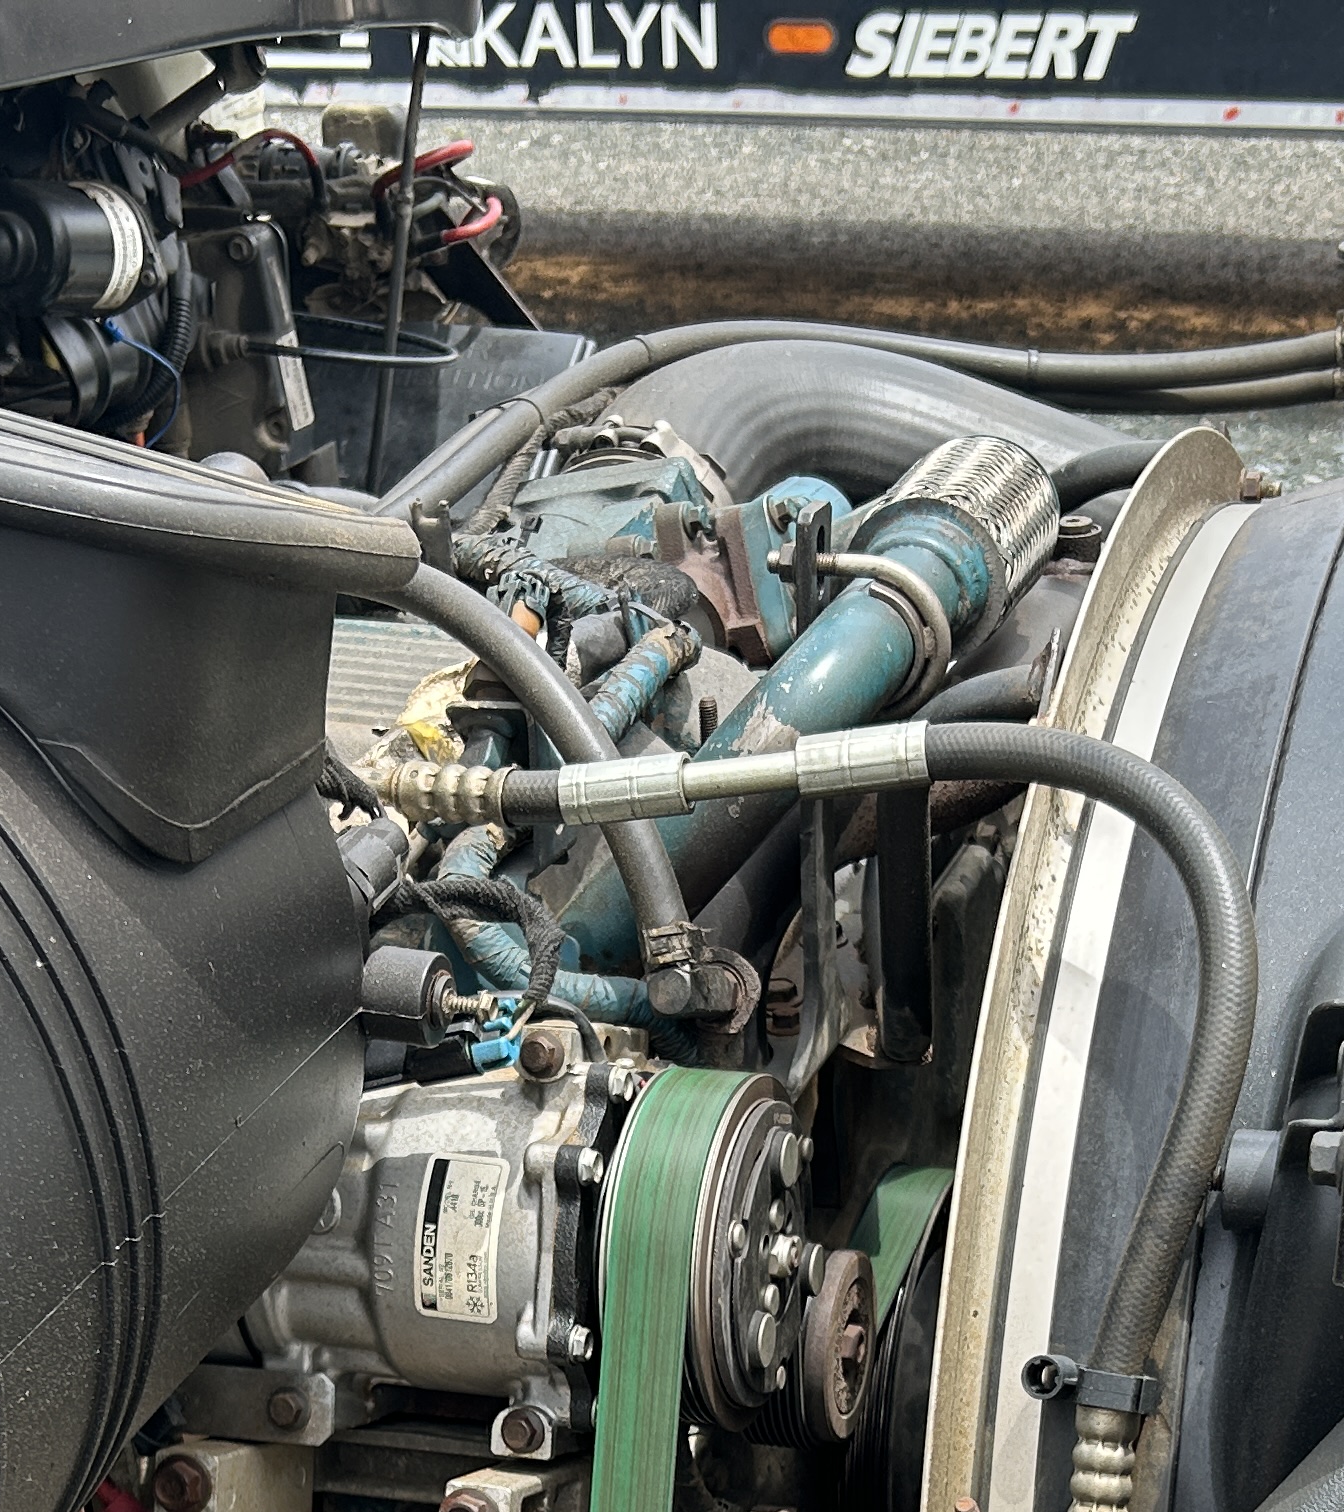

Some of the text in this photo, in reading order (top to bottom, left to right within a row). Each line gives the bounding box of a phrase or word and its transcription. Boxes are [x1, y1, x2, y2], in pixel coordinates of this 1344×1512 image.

[469, 0, 717, 68] KALYN
[845, 11, 1139, 80] SIEBERT
[423, 1223, 437, 1287] SANDEN
[467, 1254, 479, 1293] R134a
